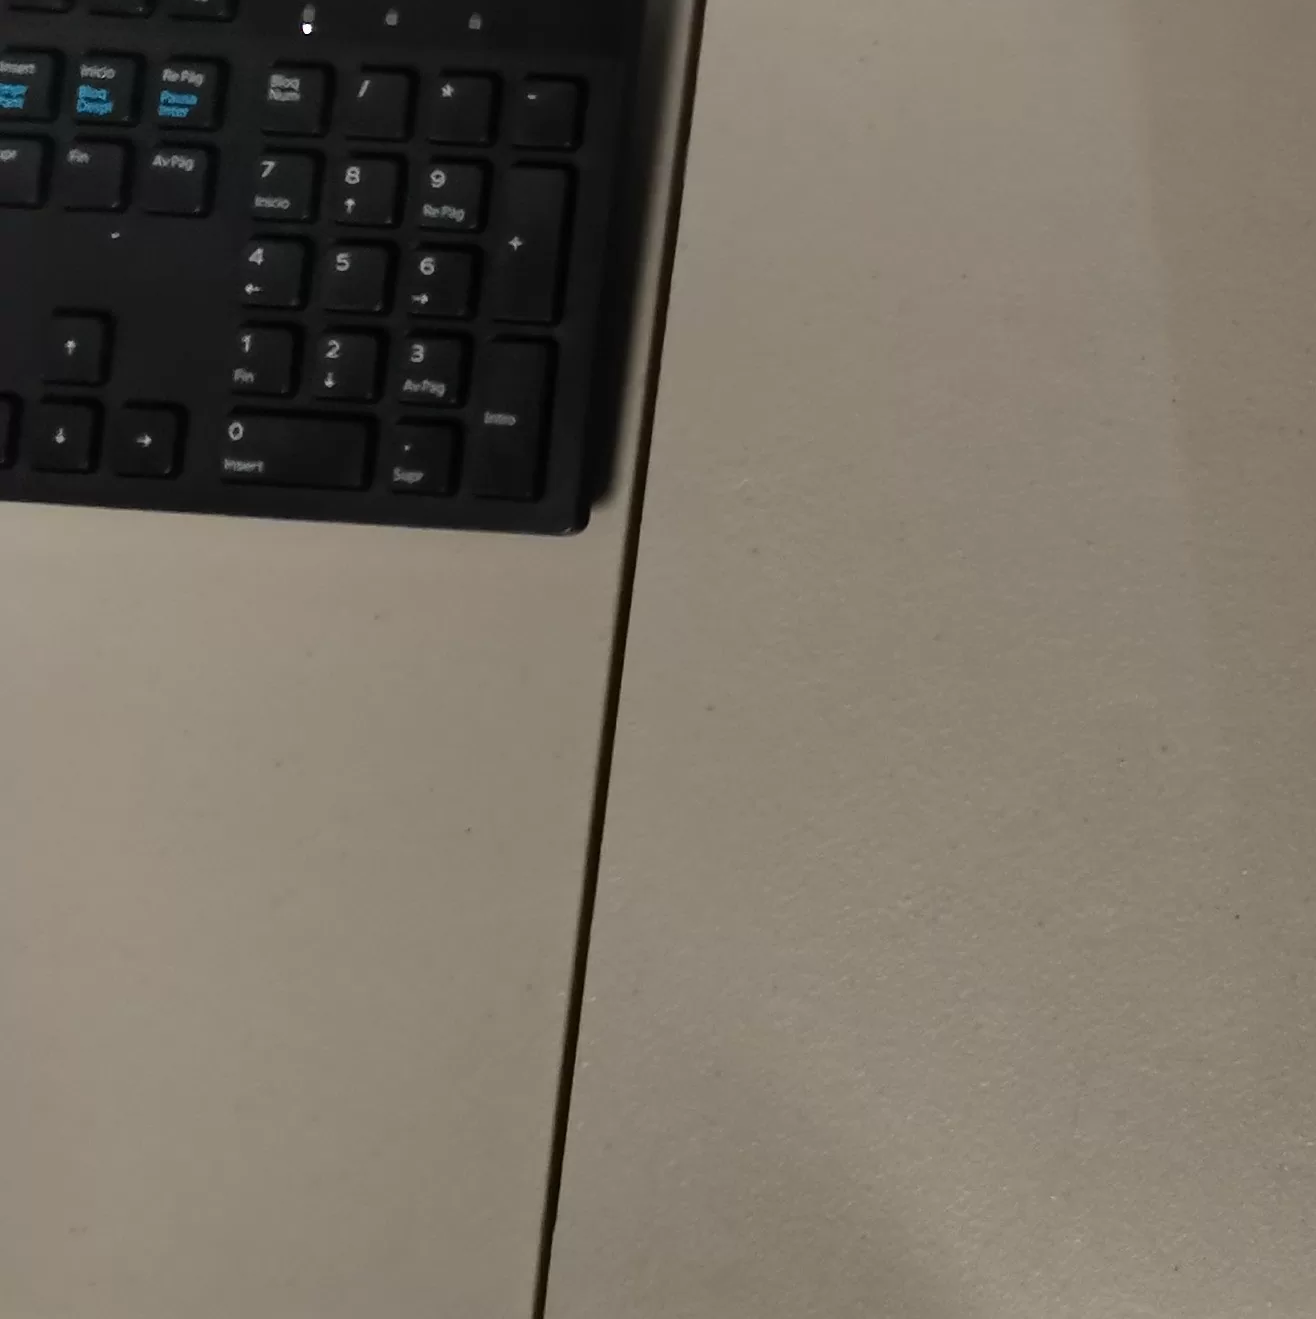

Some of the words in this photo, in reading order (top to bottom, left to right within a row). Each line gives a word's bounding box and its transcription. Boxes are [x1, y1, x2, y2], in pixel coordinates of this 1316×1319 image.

[261, 160, 277, 178] 7
[344, 165, 361, 185] 8
[429, 168, 447, 189] 9
[335, 252, 351, 272] 5
[325, 339, 341, 359] 2
[410, 343, 426, 363] 3
